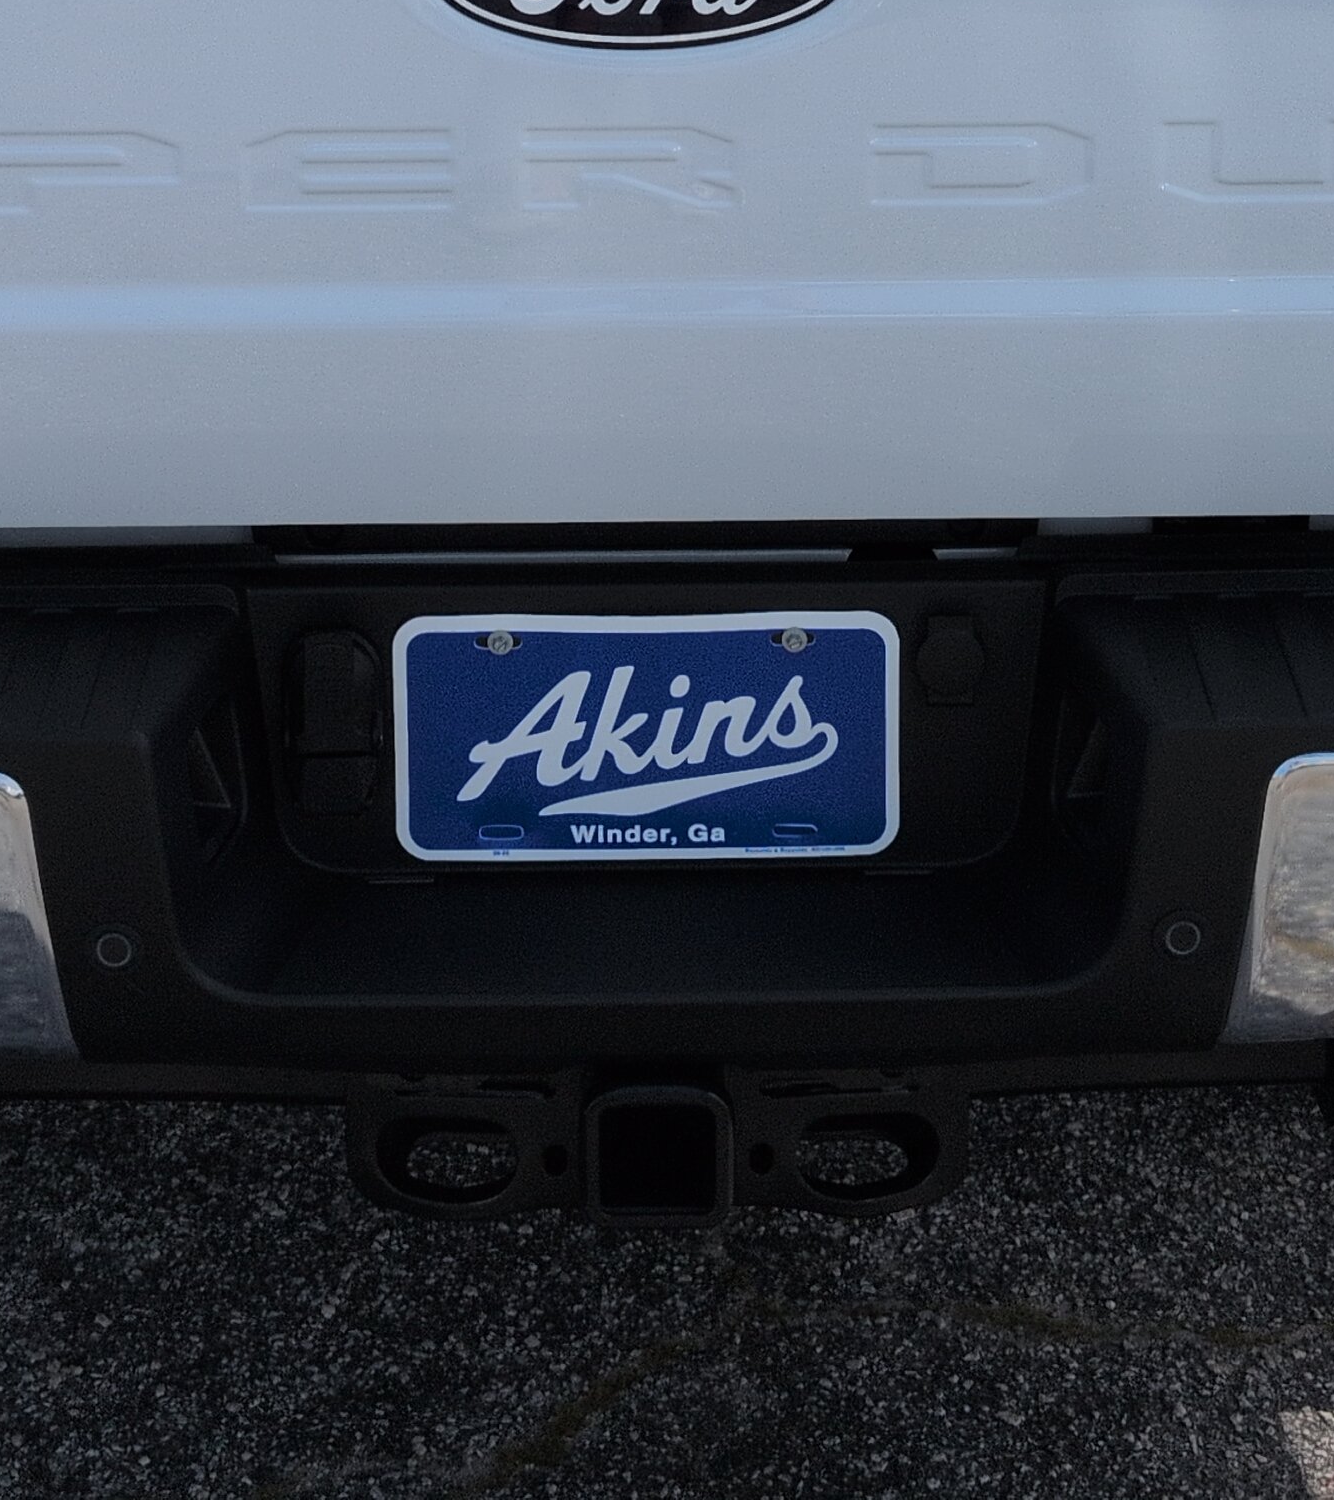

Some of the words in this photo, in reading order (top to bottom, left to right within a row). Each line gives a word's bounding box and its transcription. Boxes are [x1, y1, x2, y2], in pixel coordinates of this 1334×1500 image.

[457, 666, 839, 816] Akins
[570, 824, 678, 846] Winder,
[687, 823, 726, 843] Ga
